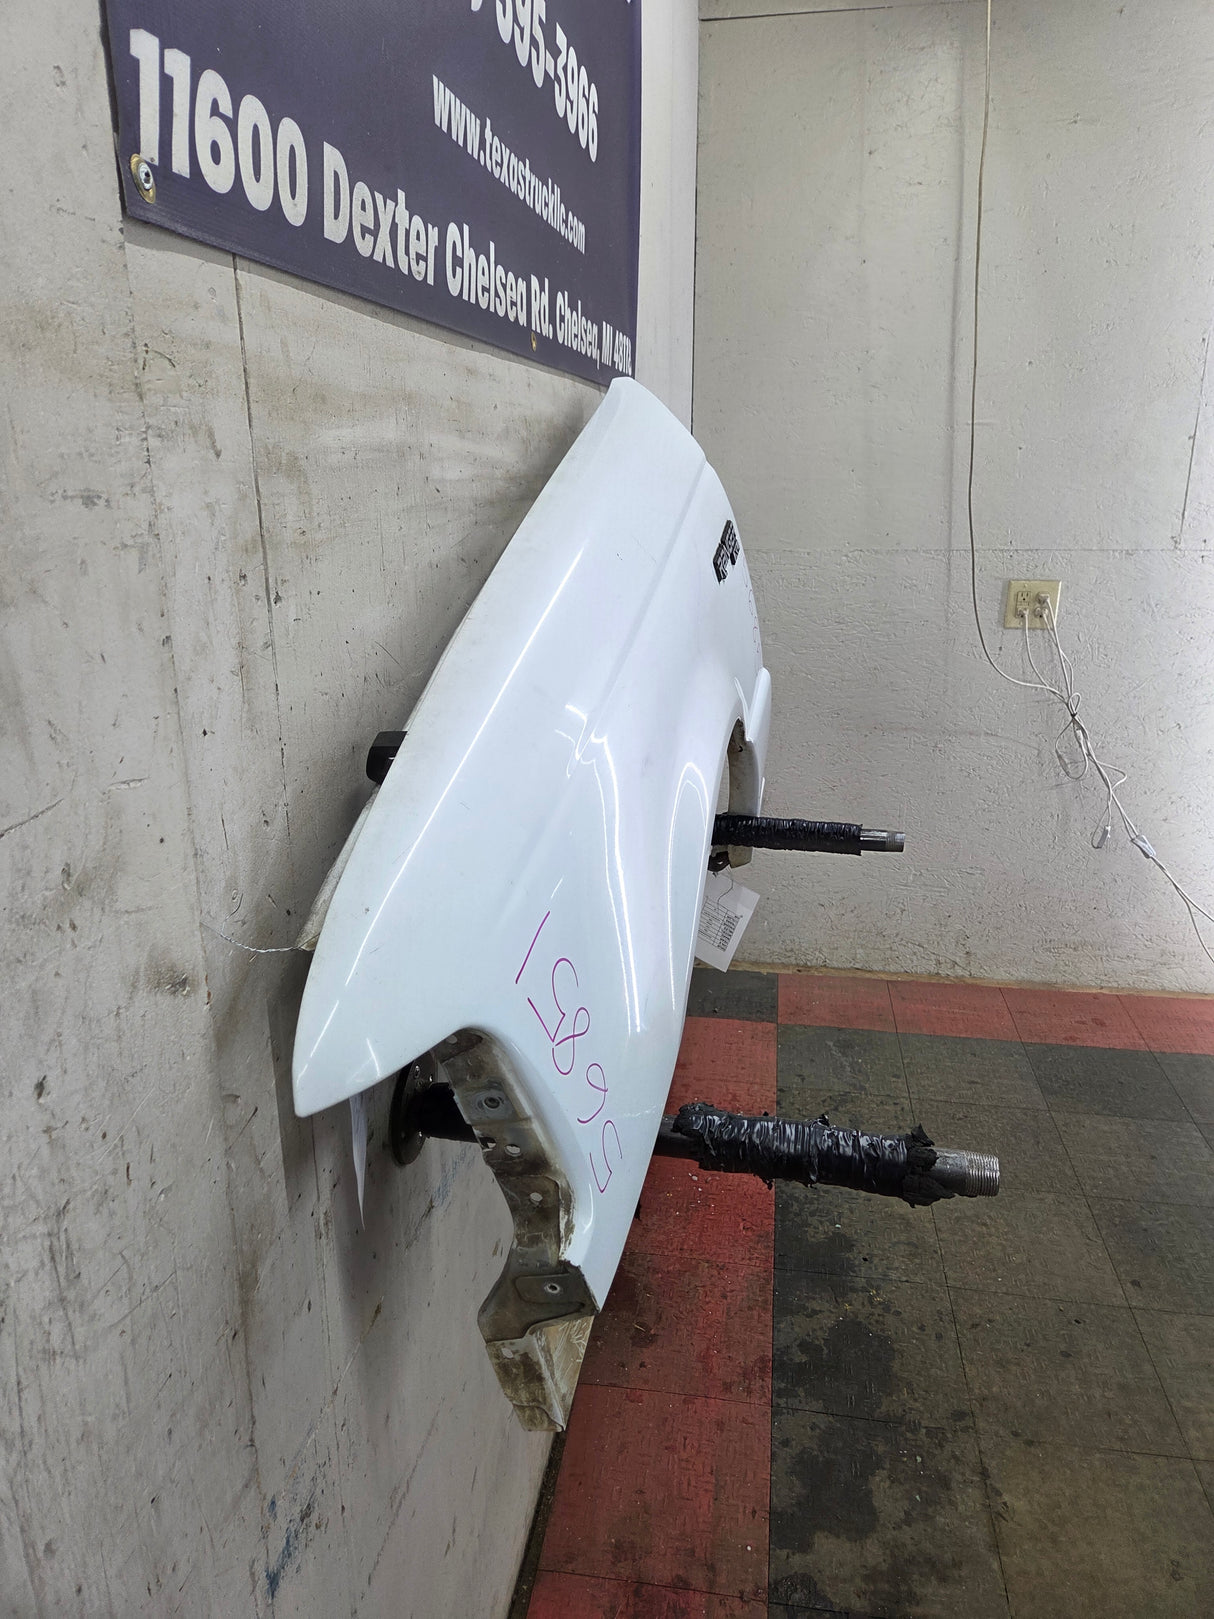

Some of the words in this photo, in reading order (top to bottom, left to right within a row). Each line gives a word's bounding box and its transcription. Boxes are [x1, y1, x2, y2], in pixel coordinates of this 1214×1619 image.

[129, 28, 308, 227] 11600
[323, 140, 438, 286] Dexter
[445, 222, 527, 327] Chelsea
[530, 273, 553, 340] Rd.
[556, 290, 600, 370] Chelsea,
[601, 320, 613, 367] MI
[432, 73, 586, 255] www.texastruckllc.com
